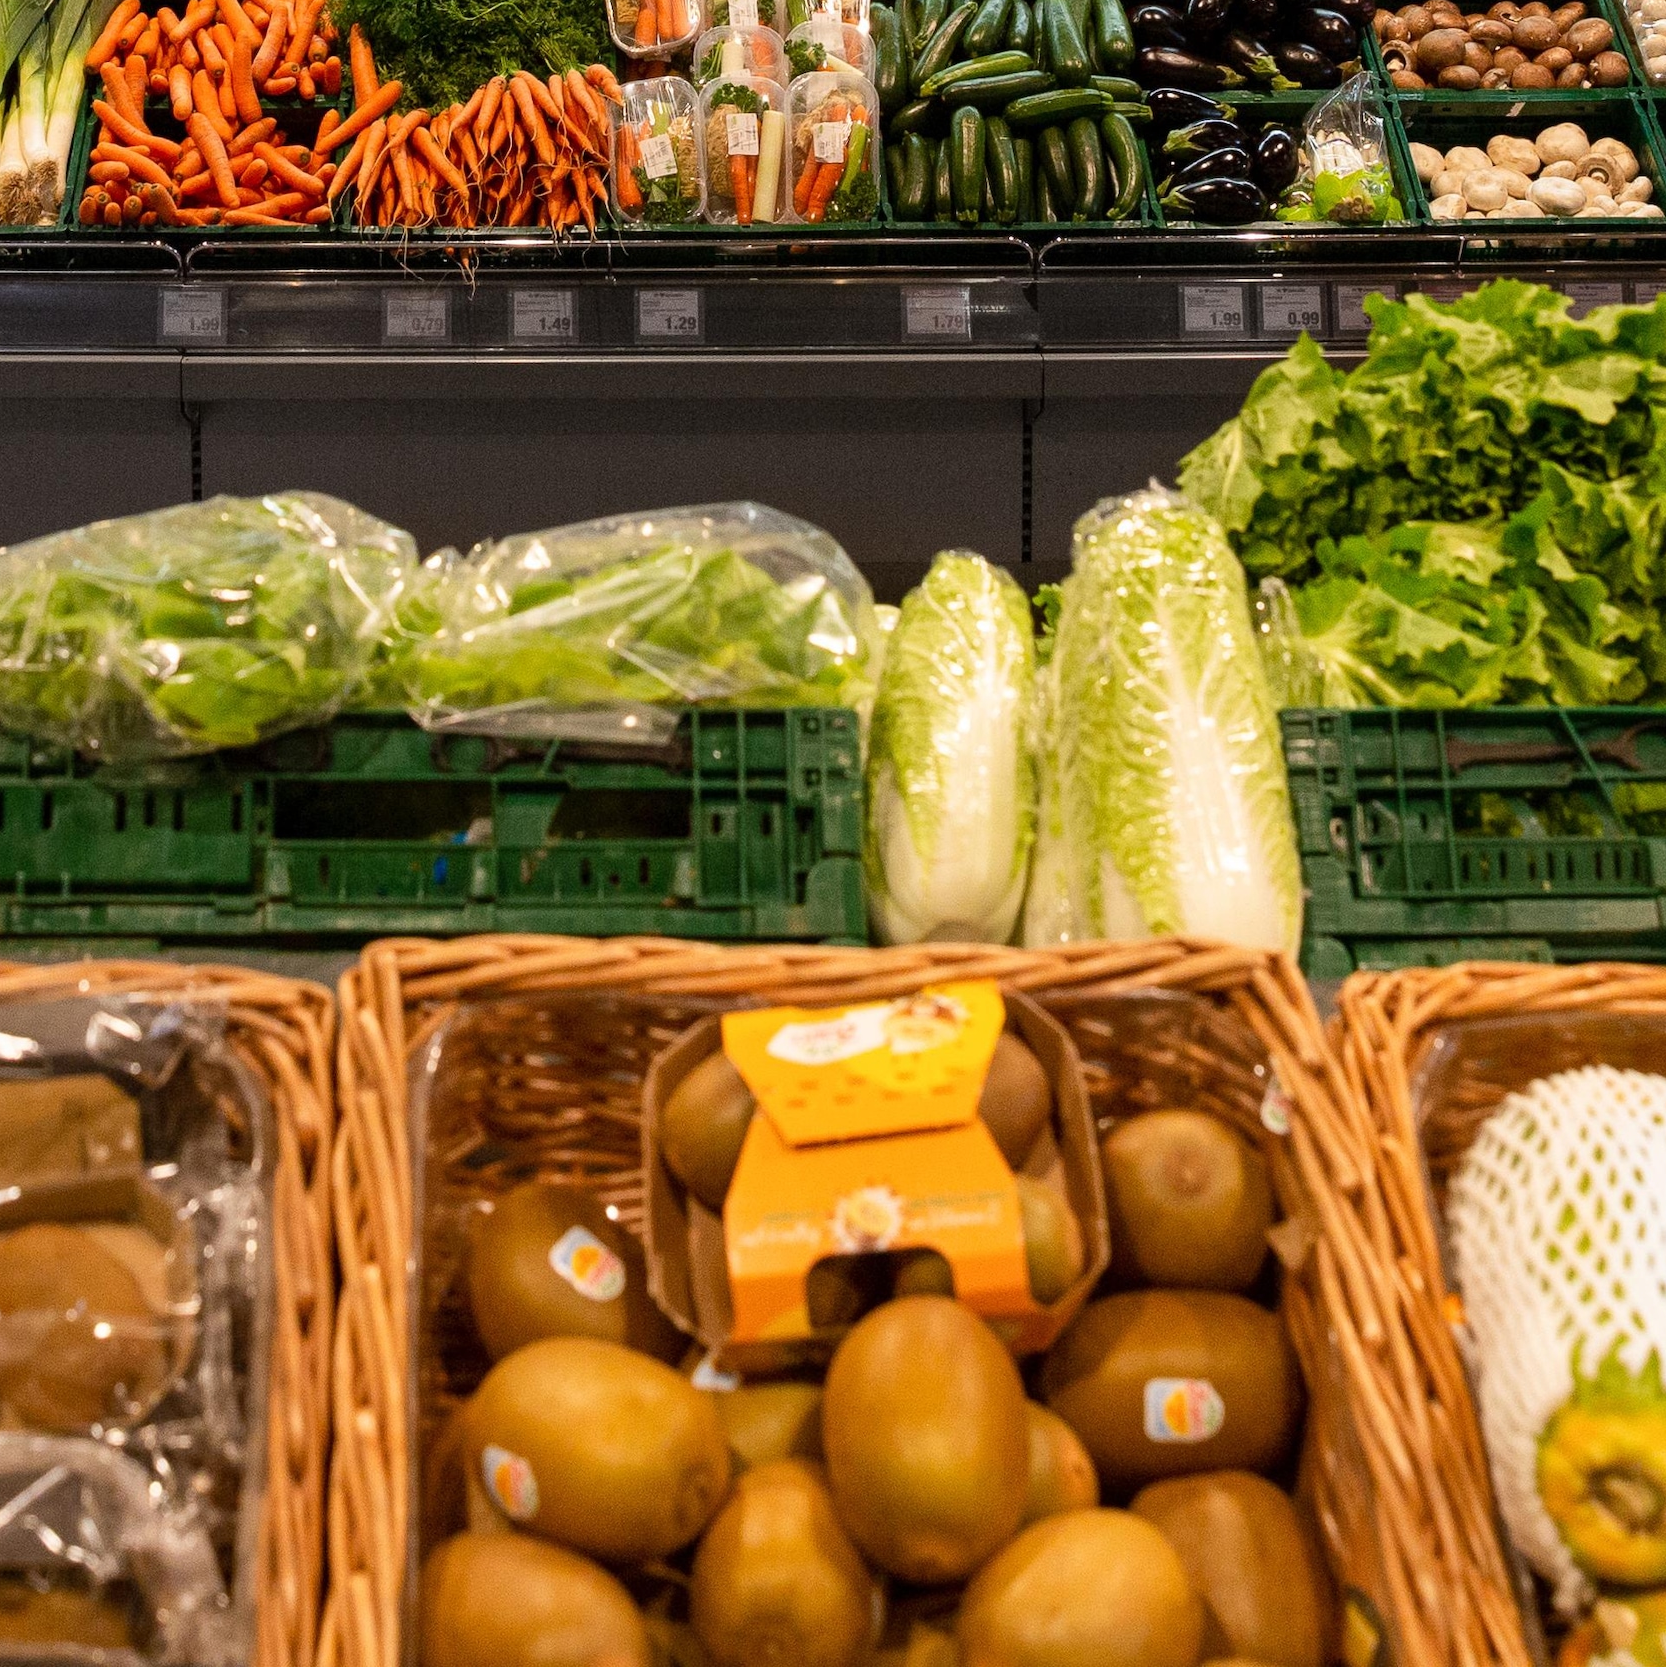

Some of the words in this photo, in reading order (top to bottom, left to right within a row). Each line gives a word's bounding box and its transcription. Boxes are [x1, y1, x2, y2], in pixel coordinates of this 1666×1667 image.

[188, 316, 221, 334] 1.99
[537, 315, 572, 333] 1.49
[663, 315, 697, 333] 1.29
[931, 314, 965, 331] 1.79
[1209, 310, 1242, 326] 1.99
[1287, 310, 1321, 326] 0.99
